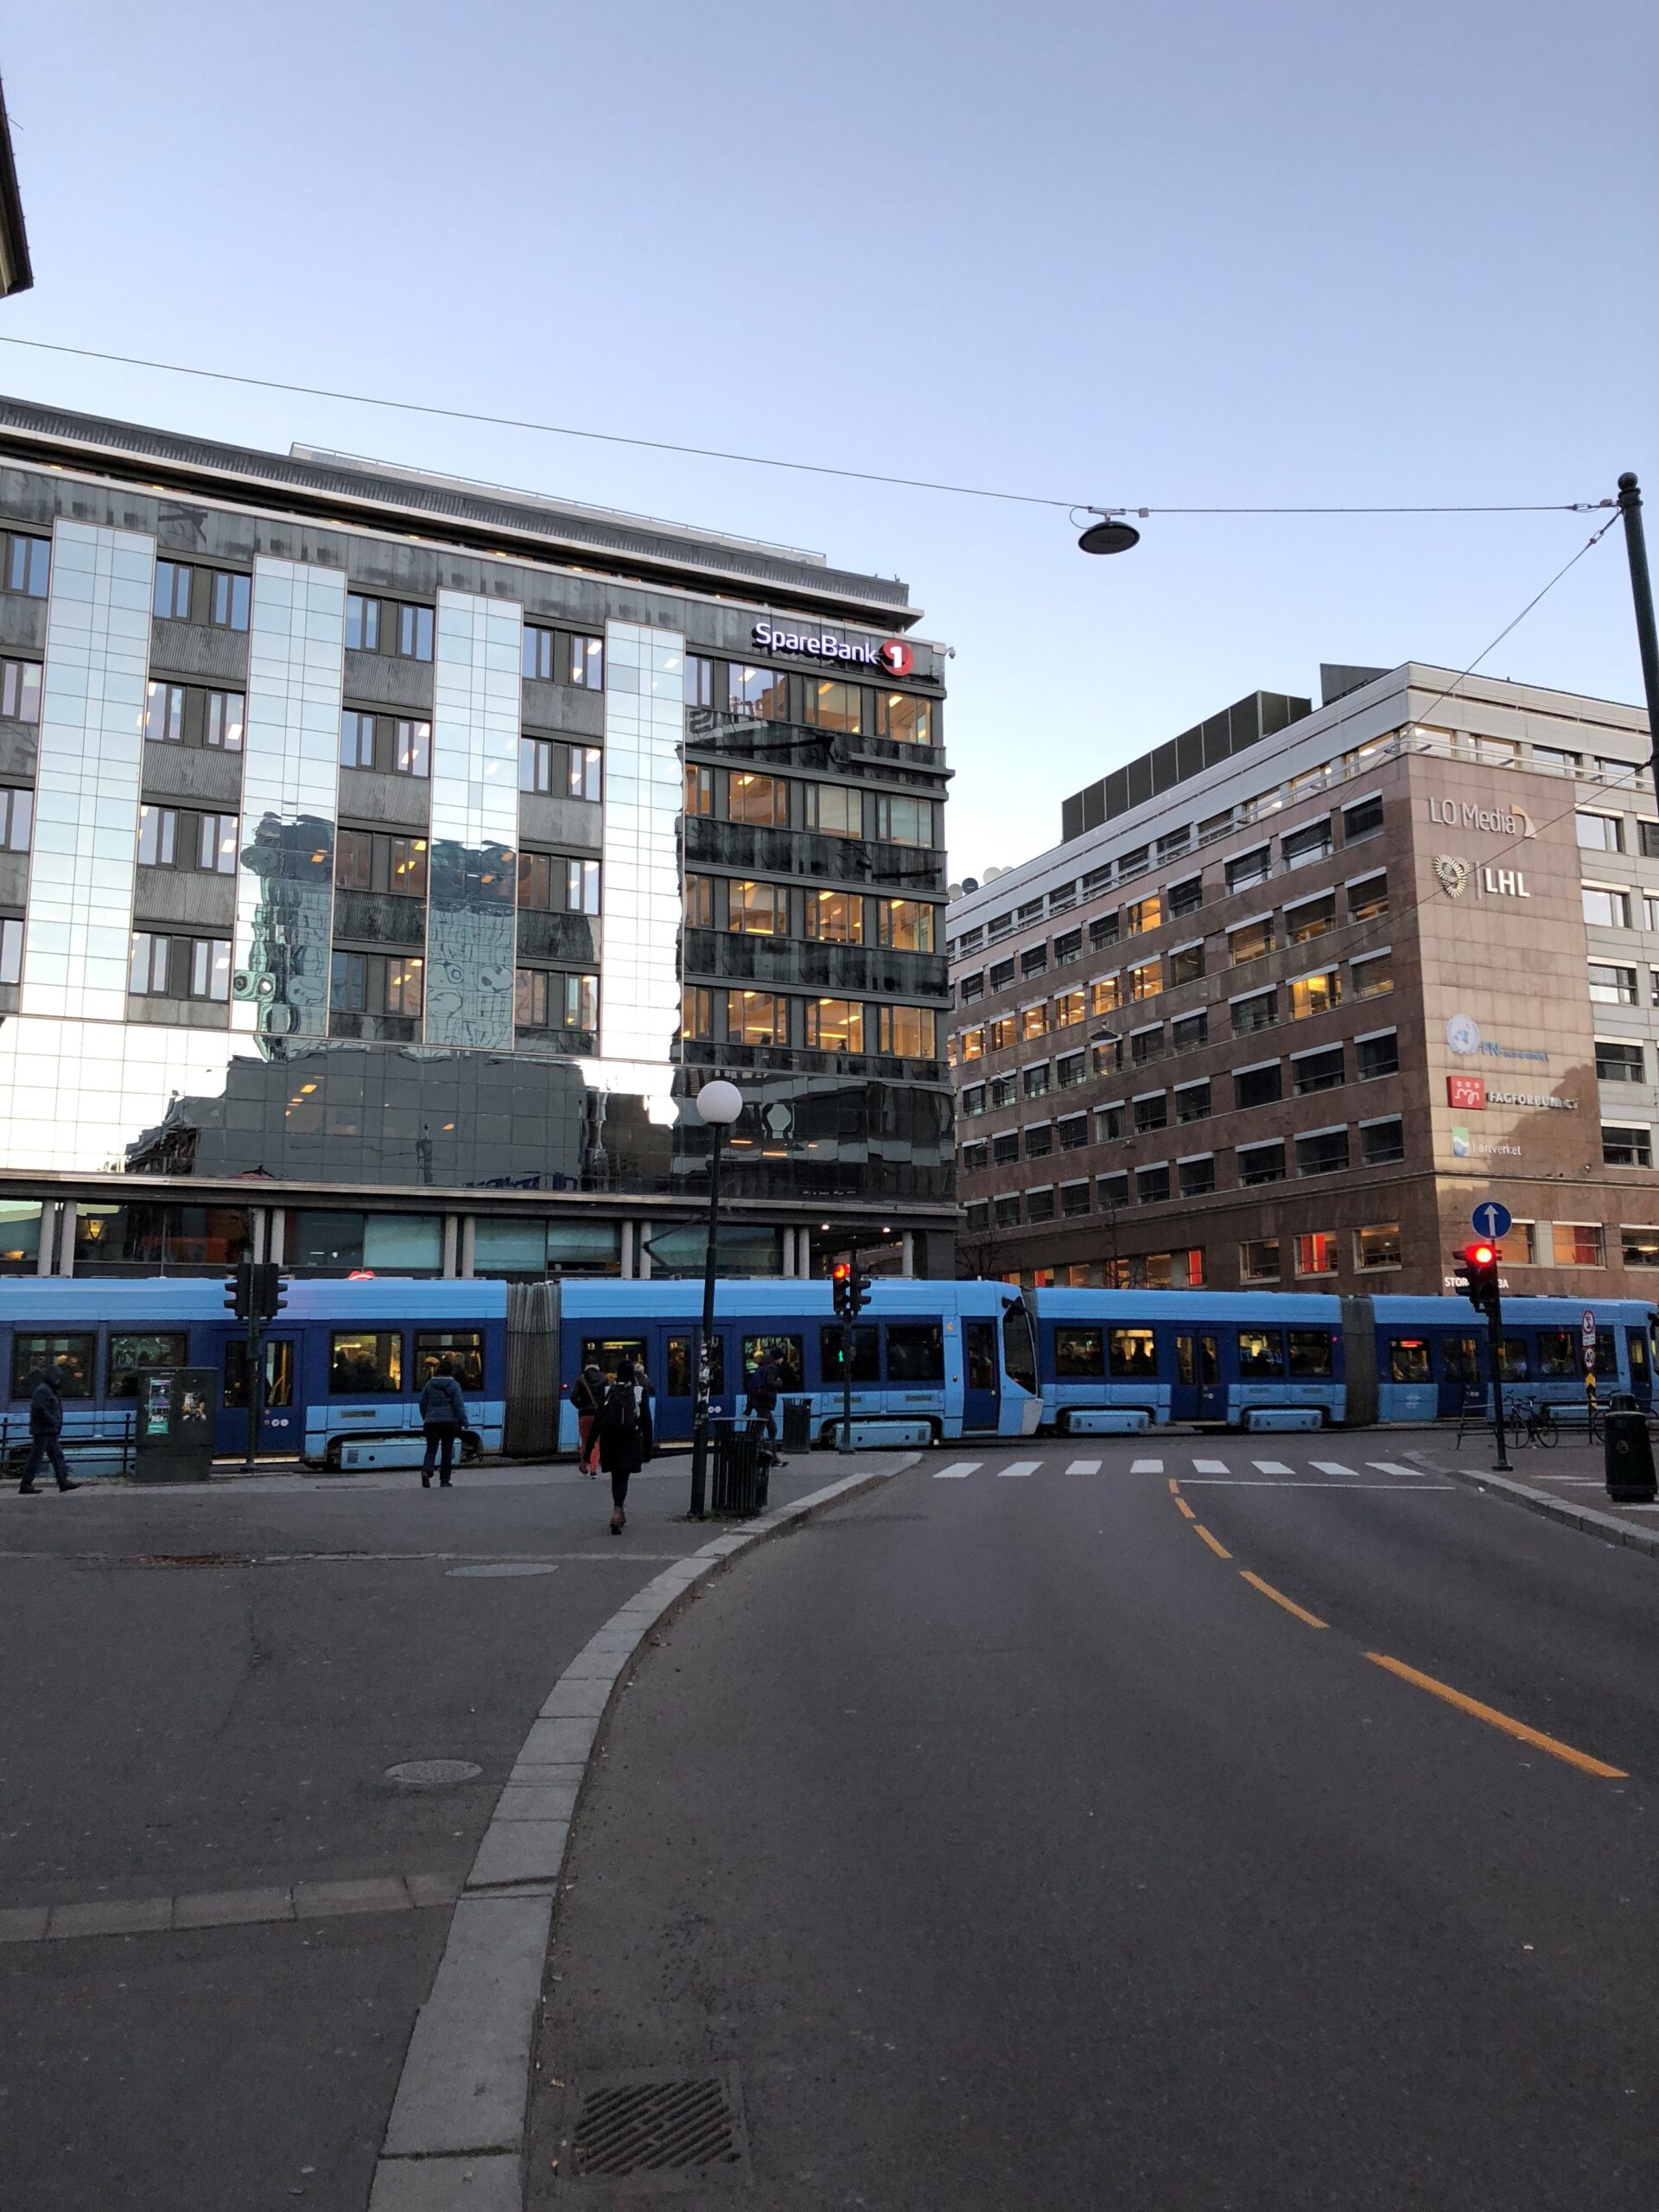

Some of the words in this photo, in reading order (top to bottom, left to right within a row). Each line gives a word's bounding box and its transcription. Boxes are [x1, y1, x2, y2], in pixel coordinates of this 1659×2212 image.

[754, 622, 878, 664] SpareBank
[890, 645, 902, 669] 1
[1429, 796, 1457, 825] LO
[1461, 802, 1516, 835] Media
[1484, 867, 1531, 898] LHL
